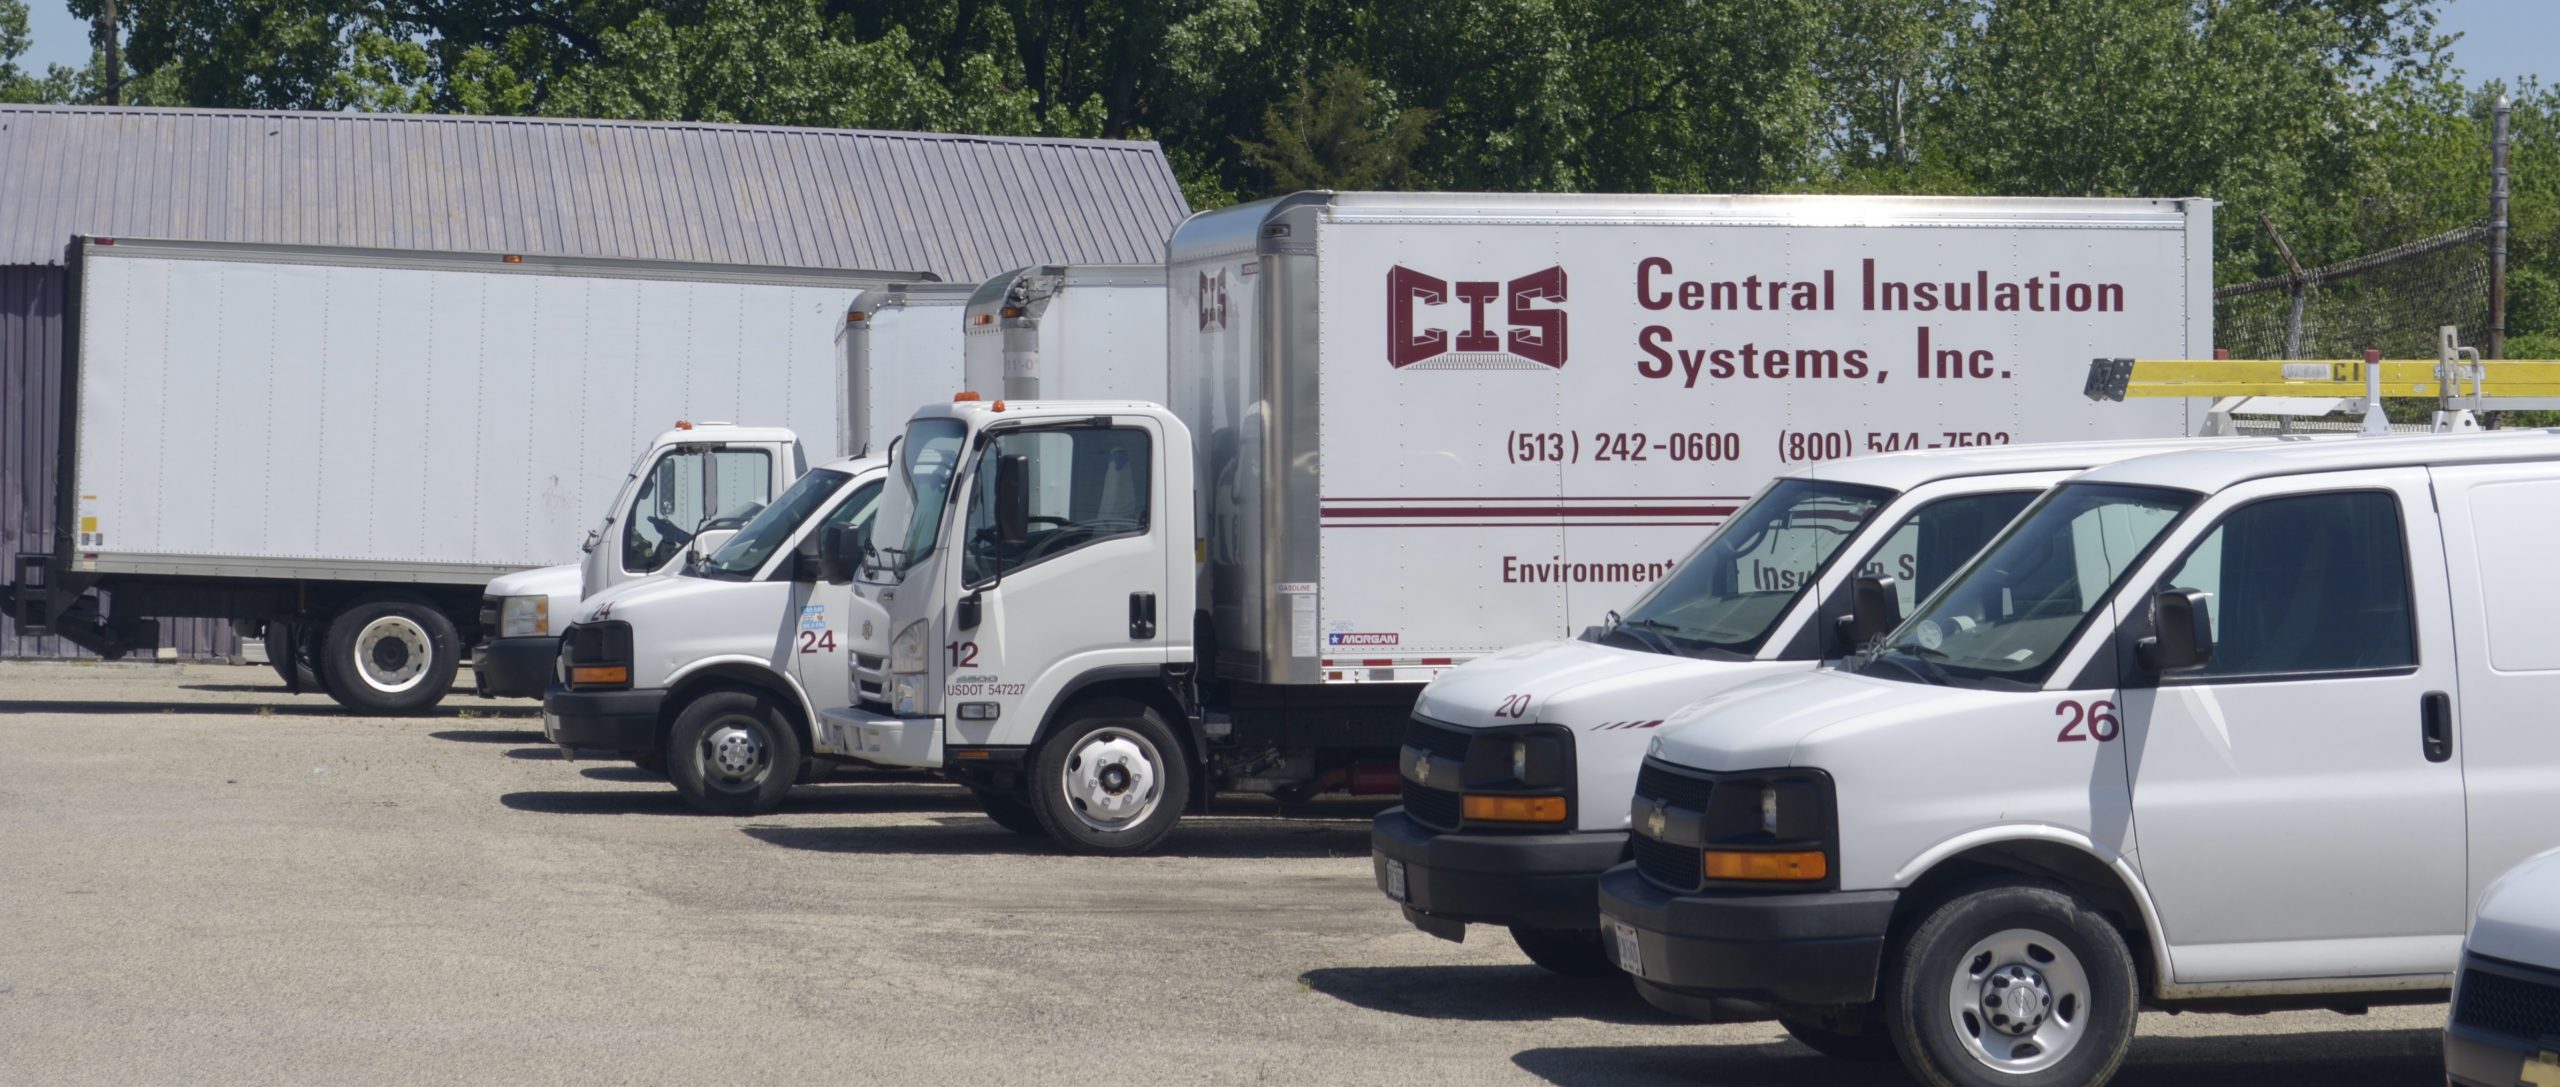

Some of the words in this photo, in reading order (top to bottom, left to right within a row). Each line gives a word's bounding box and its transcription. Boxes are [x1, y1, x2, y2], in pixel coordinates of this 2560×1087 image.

[1637, 257, 1834, 311] Central
[1863, 258, 2123, 311] Insulation
[1199, 266, 1226, 332] CIS
[1387, 264, 1568, 369] CIS
[1637, 325, 1888, 388] Systems,
[1917, 326, 2011, 379] Inc.
[1507, 430, 1579, 464] (513)
[1594, 432, 1740, 461] 242-0600
[1778, 430, 1852, 463] (800)
[1278, 584, 1312, 592] GASOLINE
[591, 601, 616, 622] 24
[800, 630, 836, 654] 24
[1341, 634, 1397, 644] MORGAN
[946, 641, 979, 668] 12
[947, 684, 983, 696] USDOT
[988, 684, 1026, 696] 547227
[1494, 694, 1531, 719] 20
[2055, 699, 2120, 742] 26
